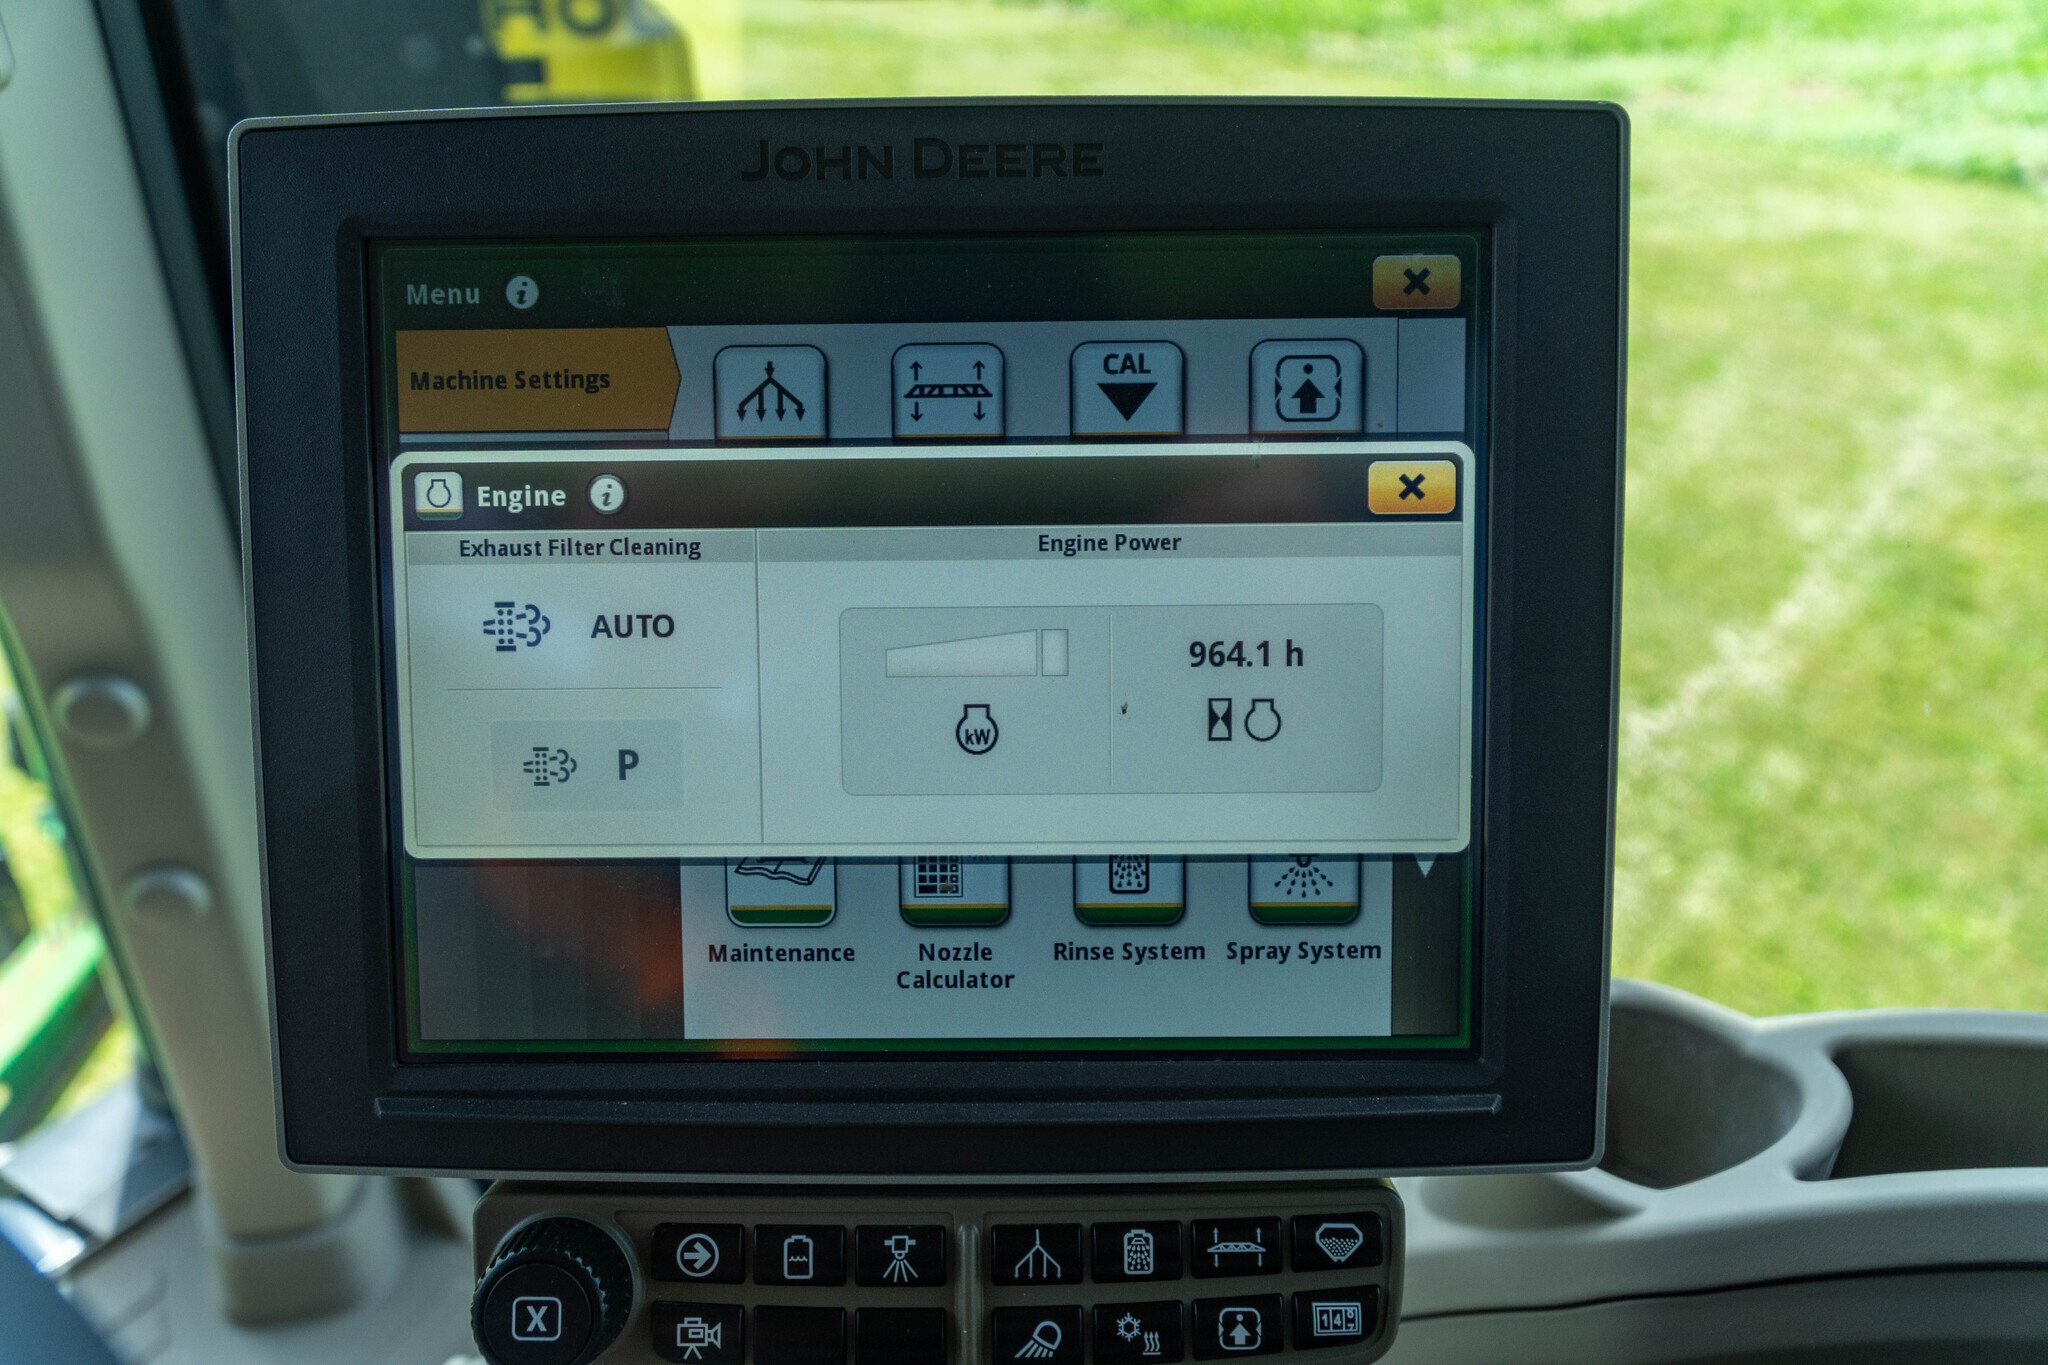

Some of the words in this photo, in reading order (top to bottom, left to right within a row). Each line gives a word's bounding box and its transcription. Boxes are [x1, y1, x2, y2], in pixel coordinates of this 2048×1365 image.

[406, 284, 480, 306] Menu
[1103, 353, 1152, 375] CAL
[410, 372, 507, 391] Machine
[514, 369, 611, 394] Settings
[477, 485, 567, 513] Engine
[459, 539, 542, 557] Exhaust
[548, 538, 605, 556] Filter
[609, 537, 702, 559] Cleaning
[1038, 535, 1109, 556] Engine
[1114, 533, 1182, 552] Power
[591, 614, 675, 639] AUTO
[1189, 640, 1271, 668] 964.1
[1286, 639, 1304, 667] h
[964, 728, 991, 746] kW
[618, 749, 640, 781] P
[708, 943, 855, 962] Maintenance
[918, 942, 993, 961] Nozzle
[1054, 942, 1114, 961] Rinse
[1122, 942, 1206, 965] System
[1227, 942, 1291, 964] Spray
[1298, 942, 1382, 964] System
[896, 970, 1015, 989] Calculator
